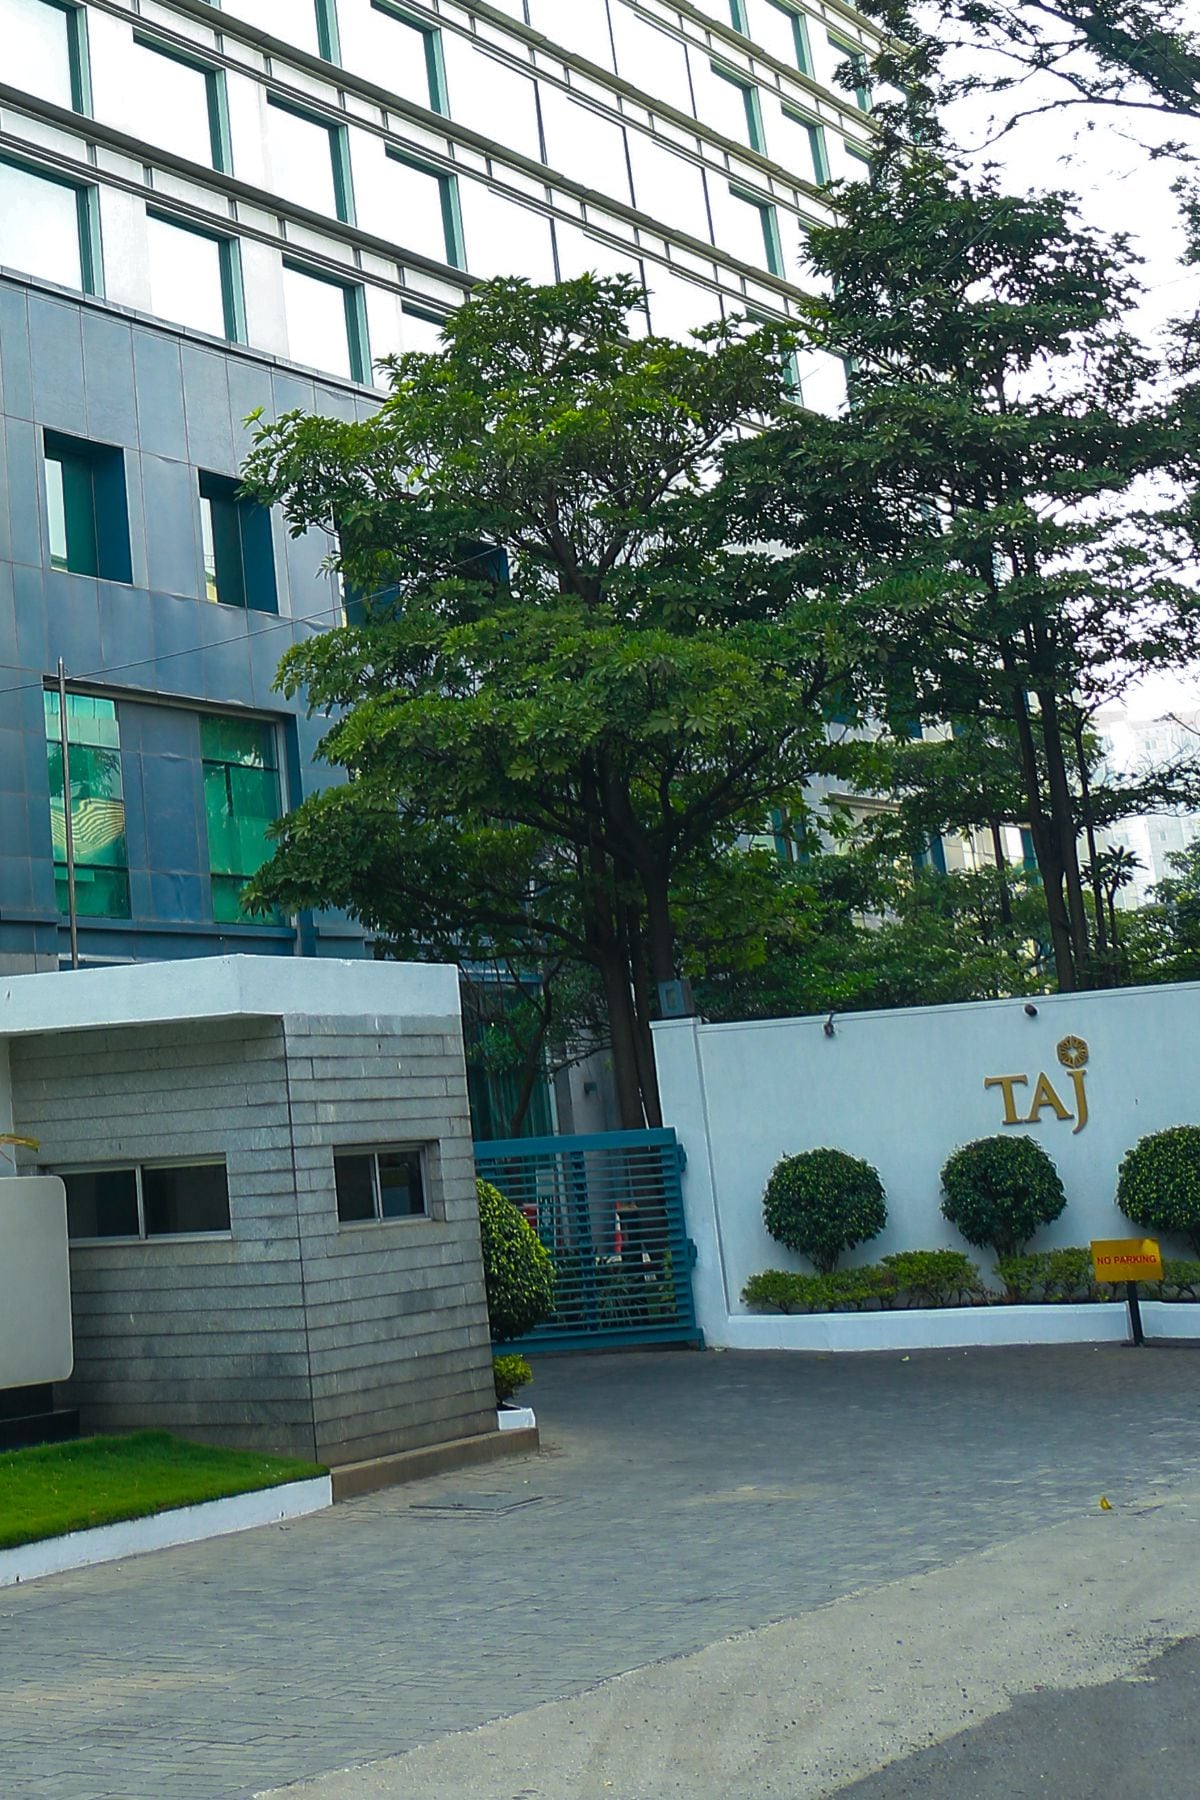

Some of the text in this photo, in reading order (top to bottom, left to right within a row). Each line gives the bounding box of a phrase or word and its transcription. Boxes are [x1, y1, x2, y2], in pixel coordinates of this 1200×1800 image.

[983, 1069, 1088, 1134] TAJ
[1096, 1254, 1158, 1265] NO PARKING
